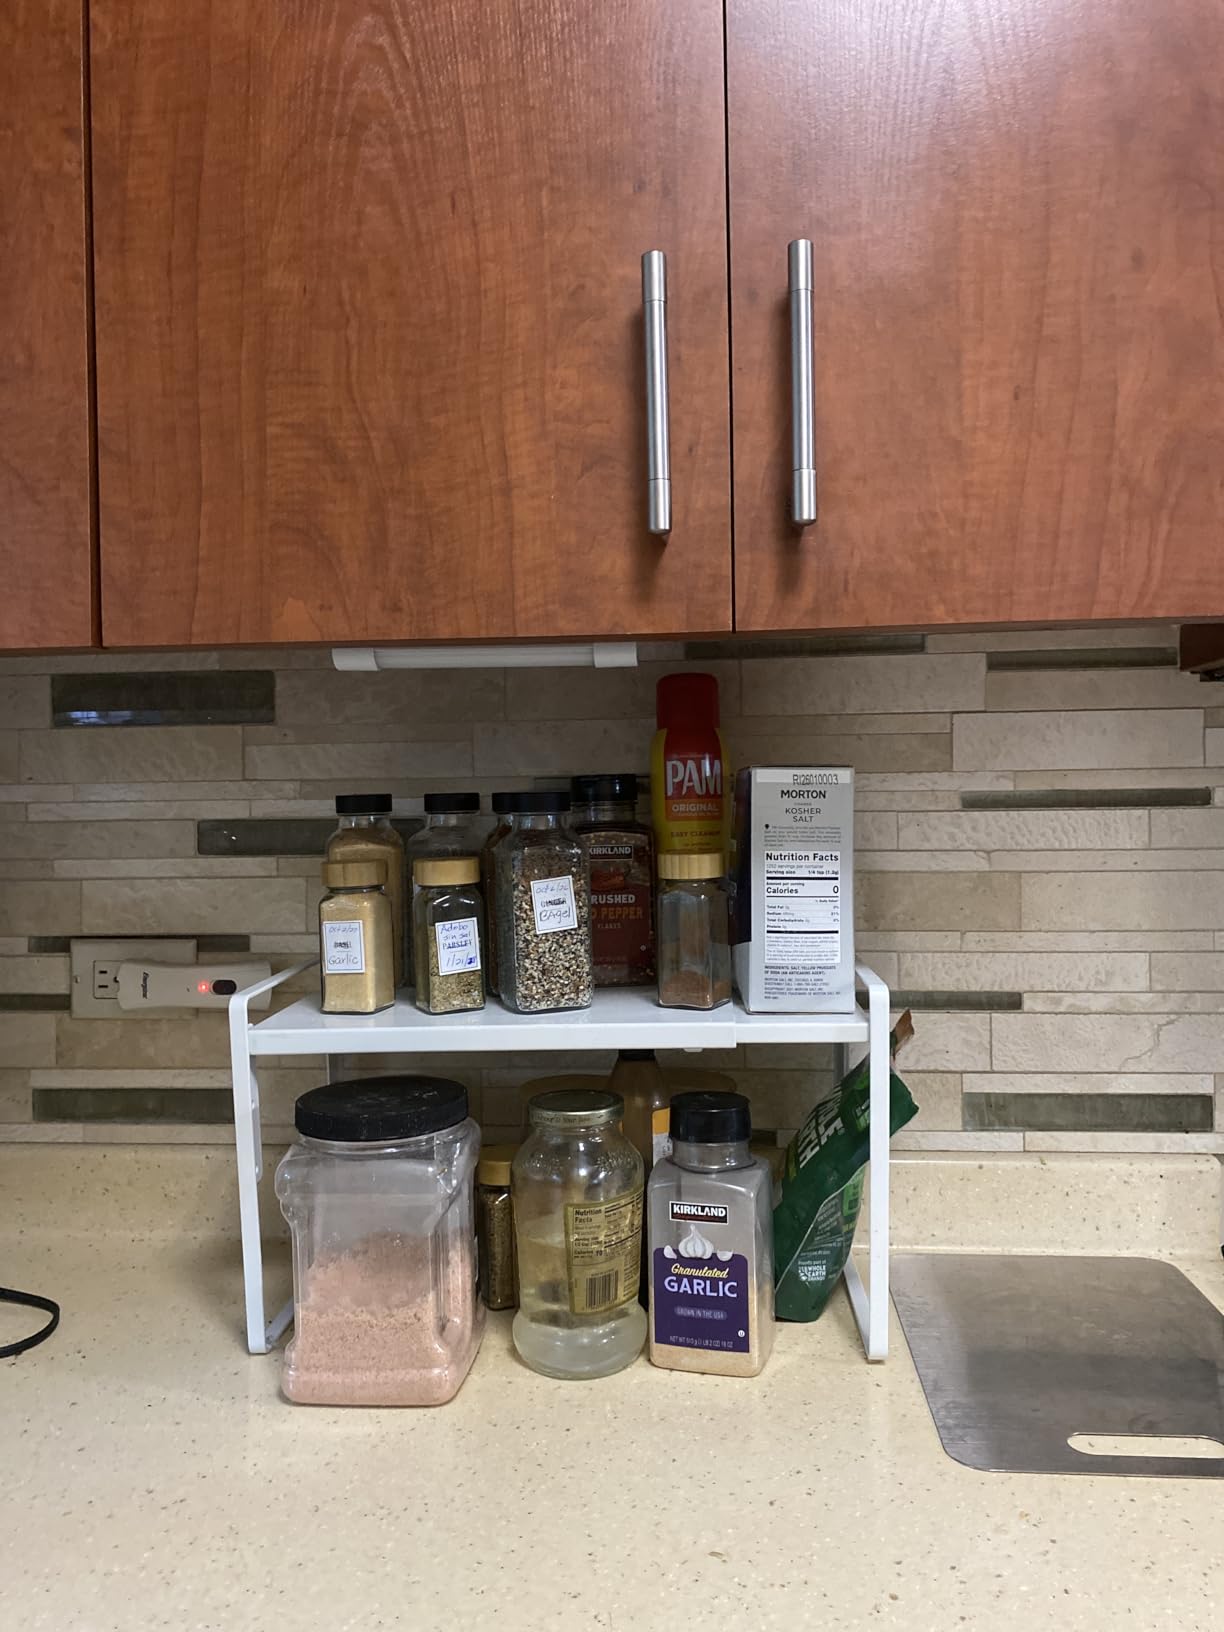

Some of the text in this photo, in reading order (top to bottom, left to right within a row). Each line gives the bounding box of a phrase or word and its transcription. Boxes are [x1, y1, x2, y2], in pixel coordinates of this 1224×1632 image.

[666, 759, 722, 796] PAM
[780, 790, 826, 799] MORTON
[672, 804, 718, 812] ORIGINAL
[766, 852, 838, 861] Nutrition Facts
[833, 886, 839, 894] 0
[591, 894, 636, 904] RUSHED
[598, 906, 642, 919] PEPPER
[329, 952, 359, 965] Garlic
[673, 1204, 726, 1218] KIRKLAND
[671, 1263, 729, 1278] Granulated
[664, 1276, 737, 1297] GARLIC
